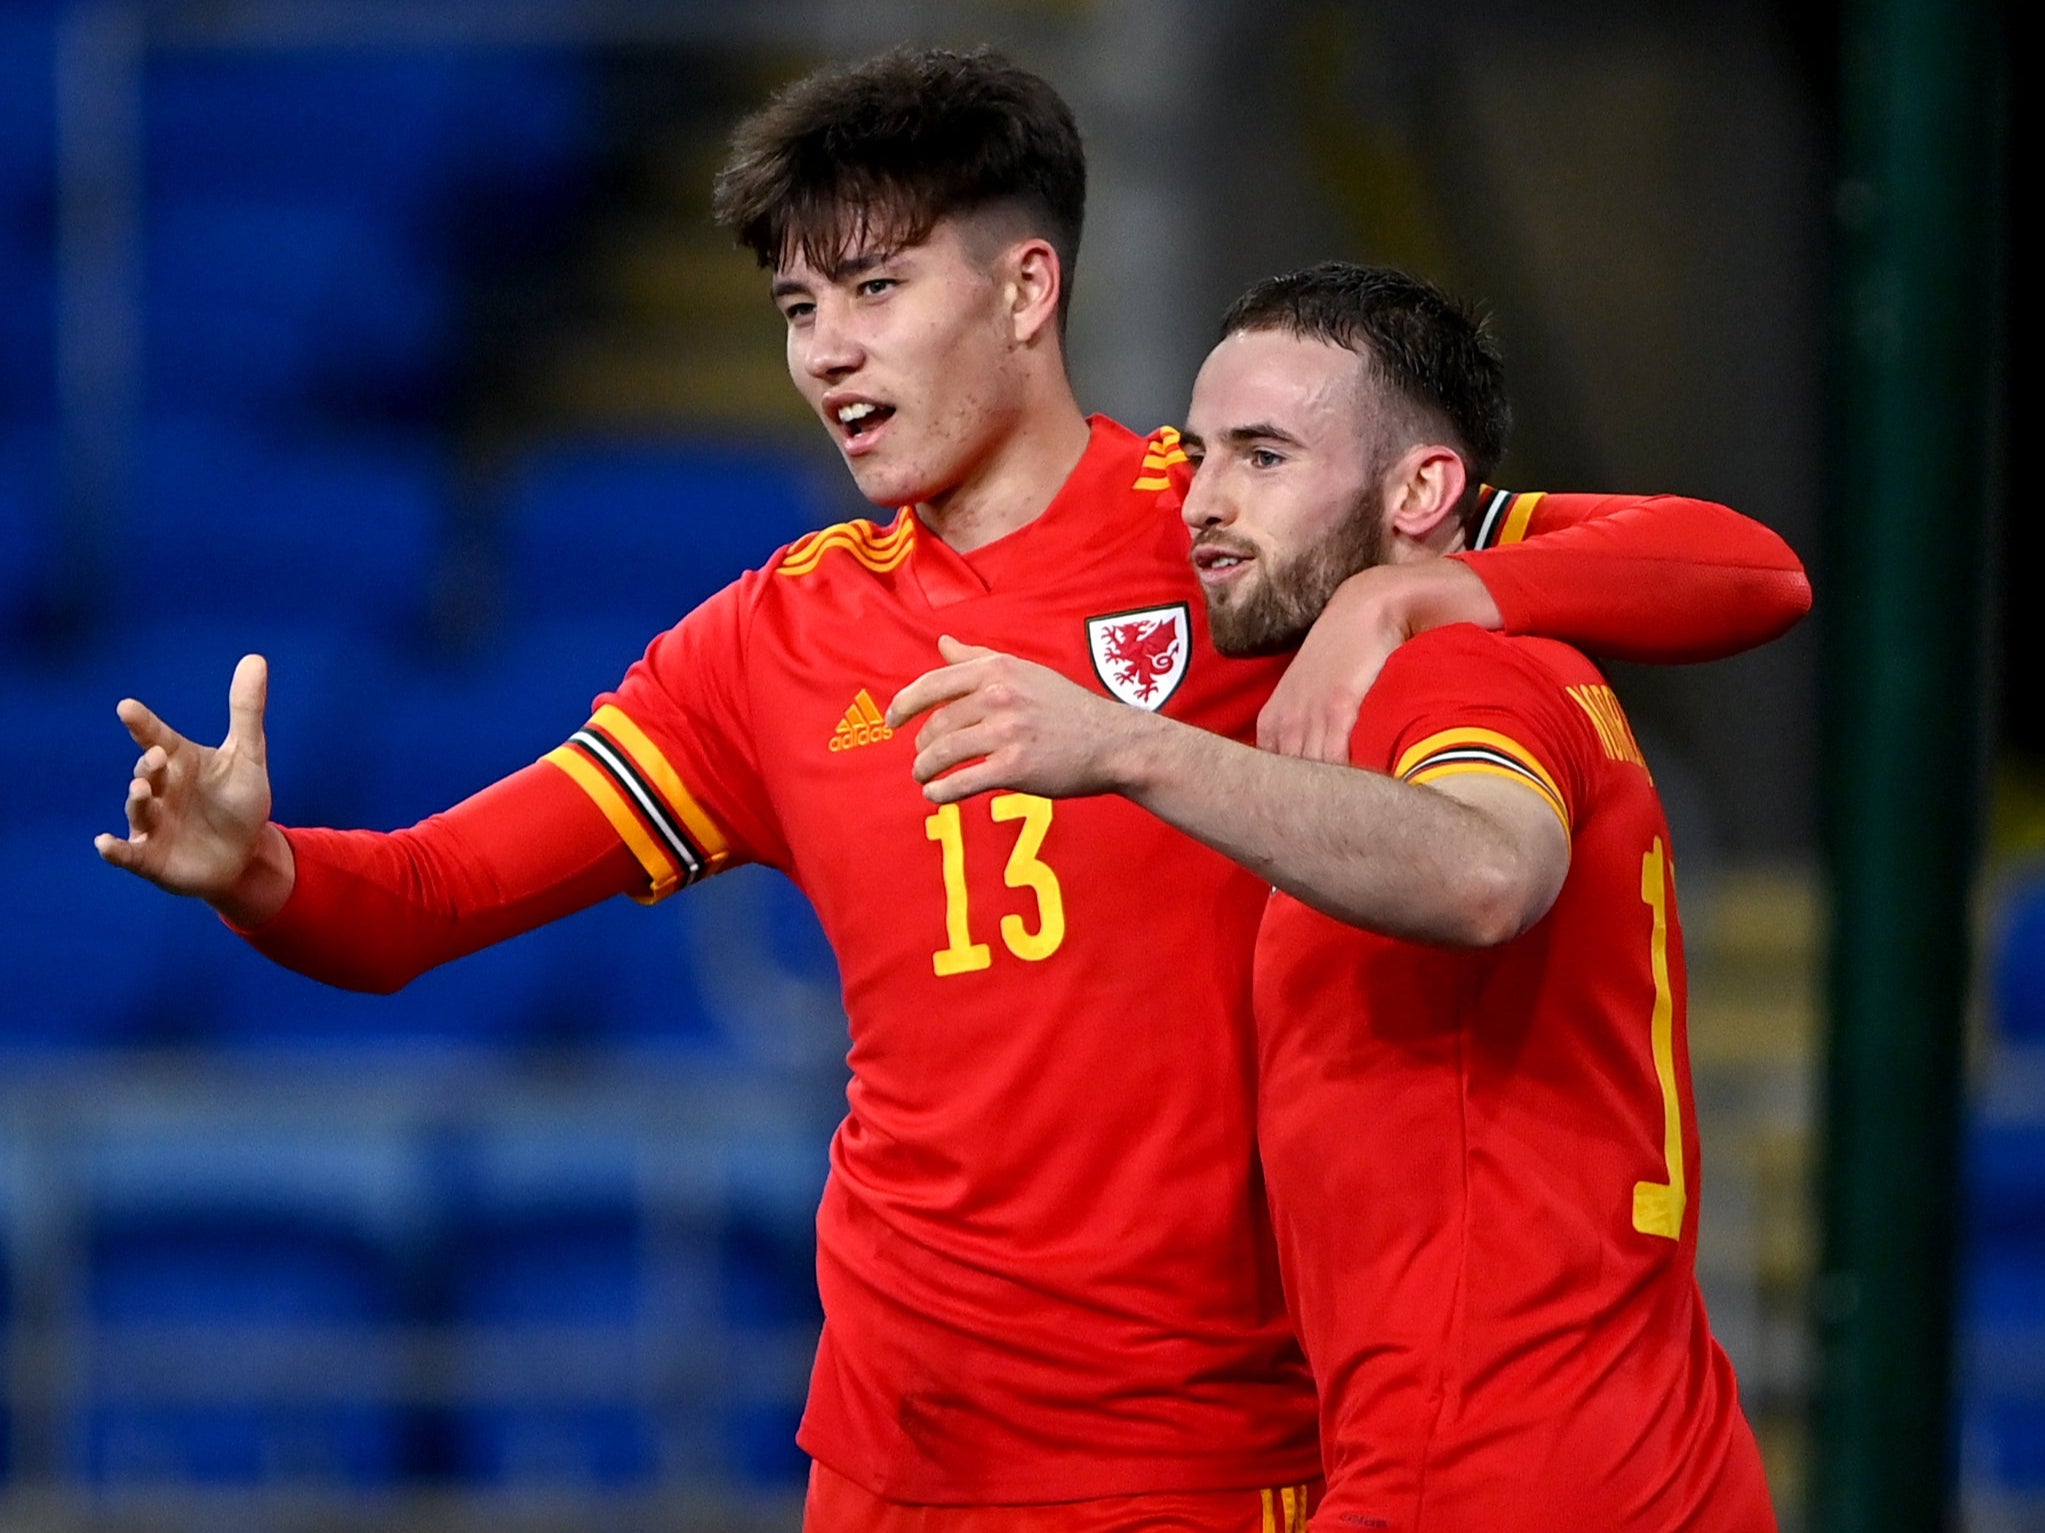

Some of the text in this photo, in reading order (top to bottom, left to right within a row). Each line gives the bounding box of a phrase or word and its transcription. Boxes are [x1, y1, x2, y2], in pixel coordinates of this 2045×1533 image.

[828, 724, 893, 752] adidas
[925, 792, 1065, 977] 13
[1632, 834, 1688, 1242] 1
